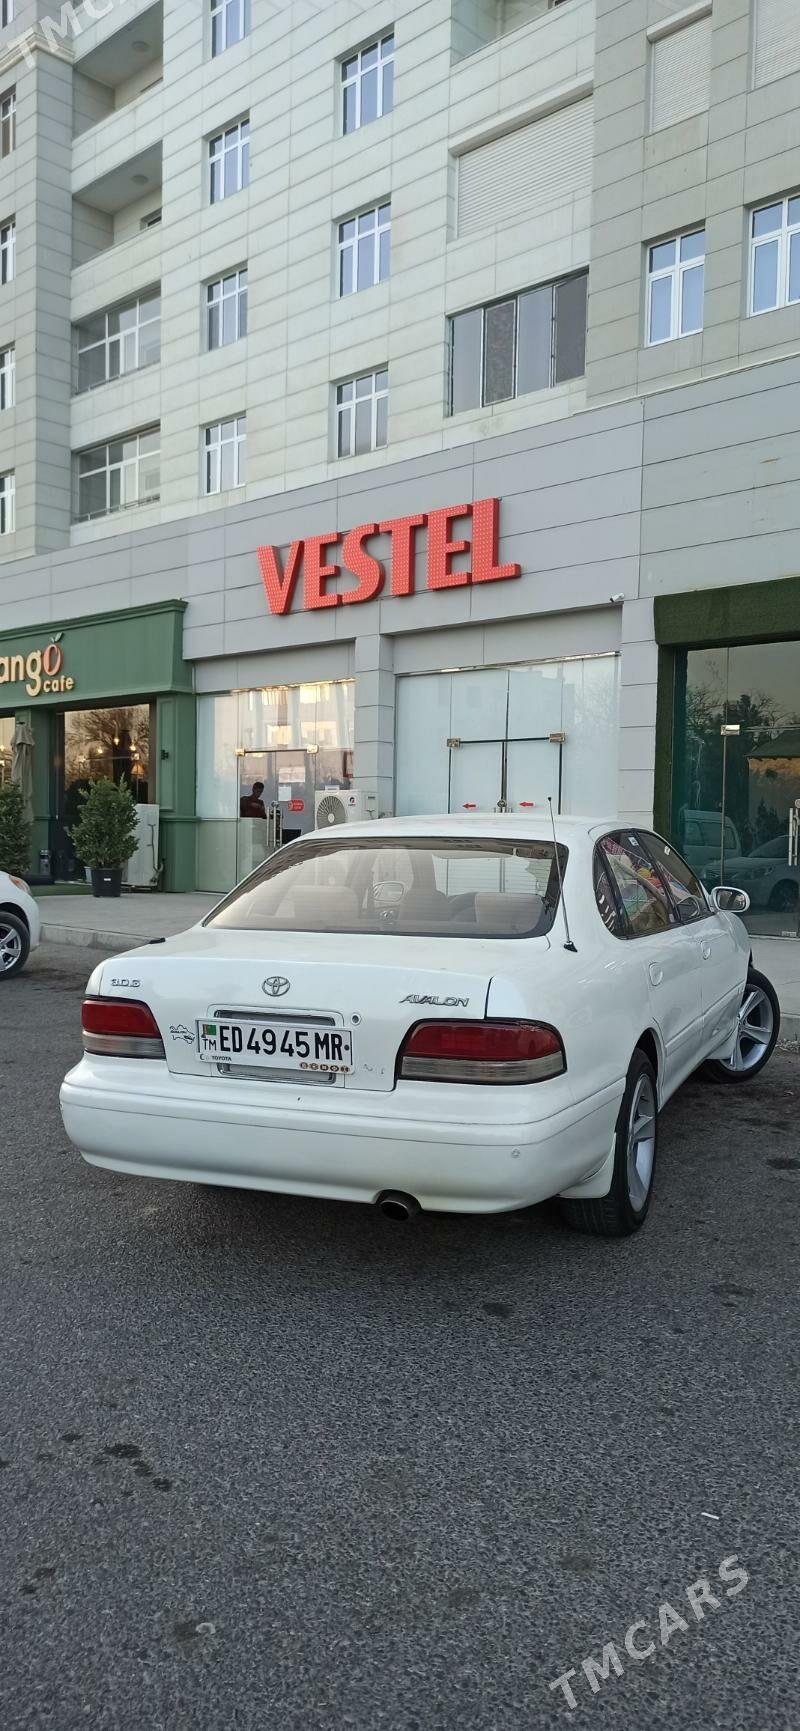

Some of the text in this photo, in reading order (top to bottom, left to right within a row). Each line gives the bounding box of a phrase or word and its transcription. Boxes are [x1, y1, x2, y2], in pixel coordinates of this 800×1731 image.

[256, 497, 521, 616] VESTEL
[43, 675, 75, 693] cafe
[398, 994, 470, 1008] AVALON
[202, 1038, 217, 1051] TM
